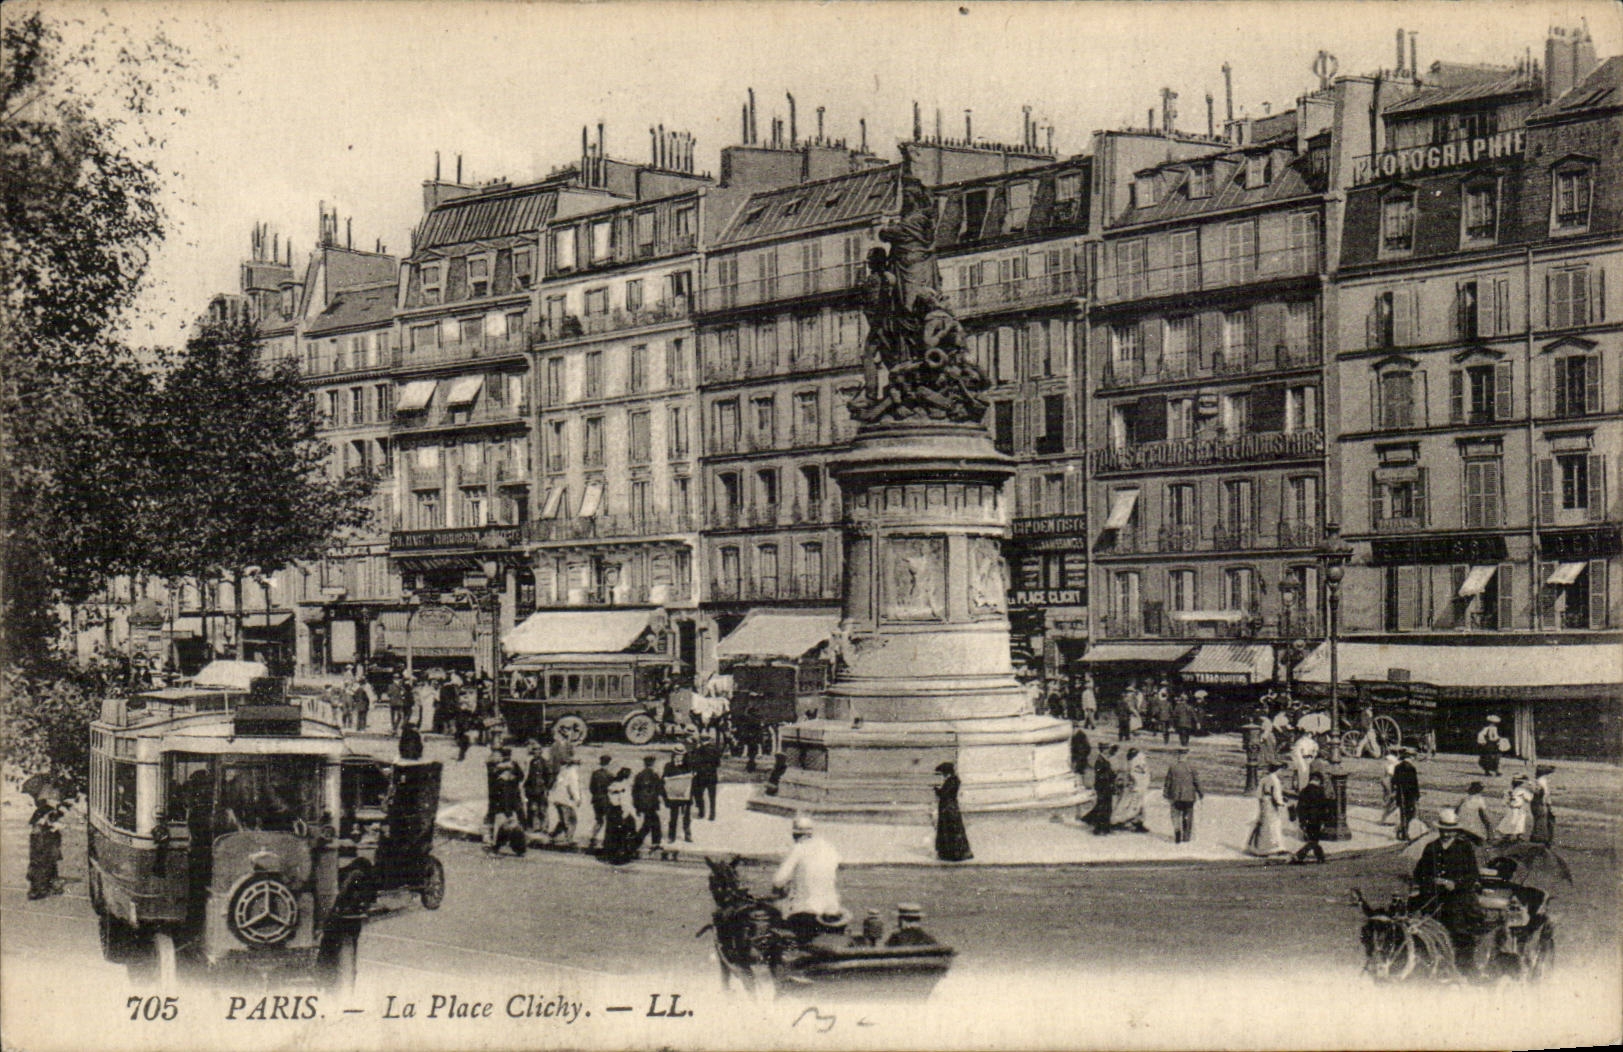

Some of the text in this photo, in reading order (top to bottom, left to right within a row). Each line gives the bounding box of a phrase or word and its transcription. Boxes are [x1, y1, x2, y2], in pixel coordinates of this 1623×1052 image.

[1033, 517, 1087, 534] DENTISTE
[1017, 590, 1047, 605] PLACE
[1048, 590, 1081, 604] CLICHY
